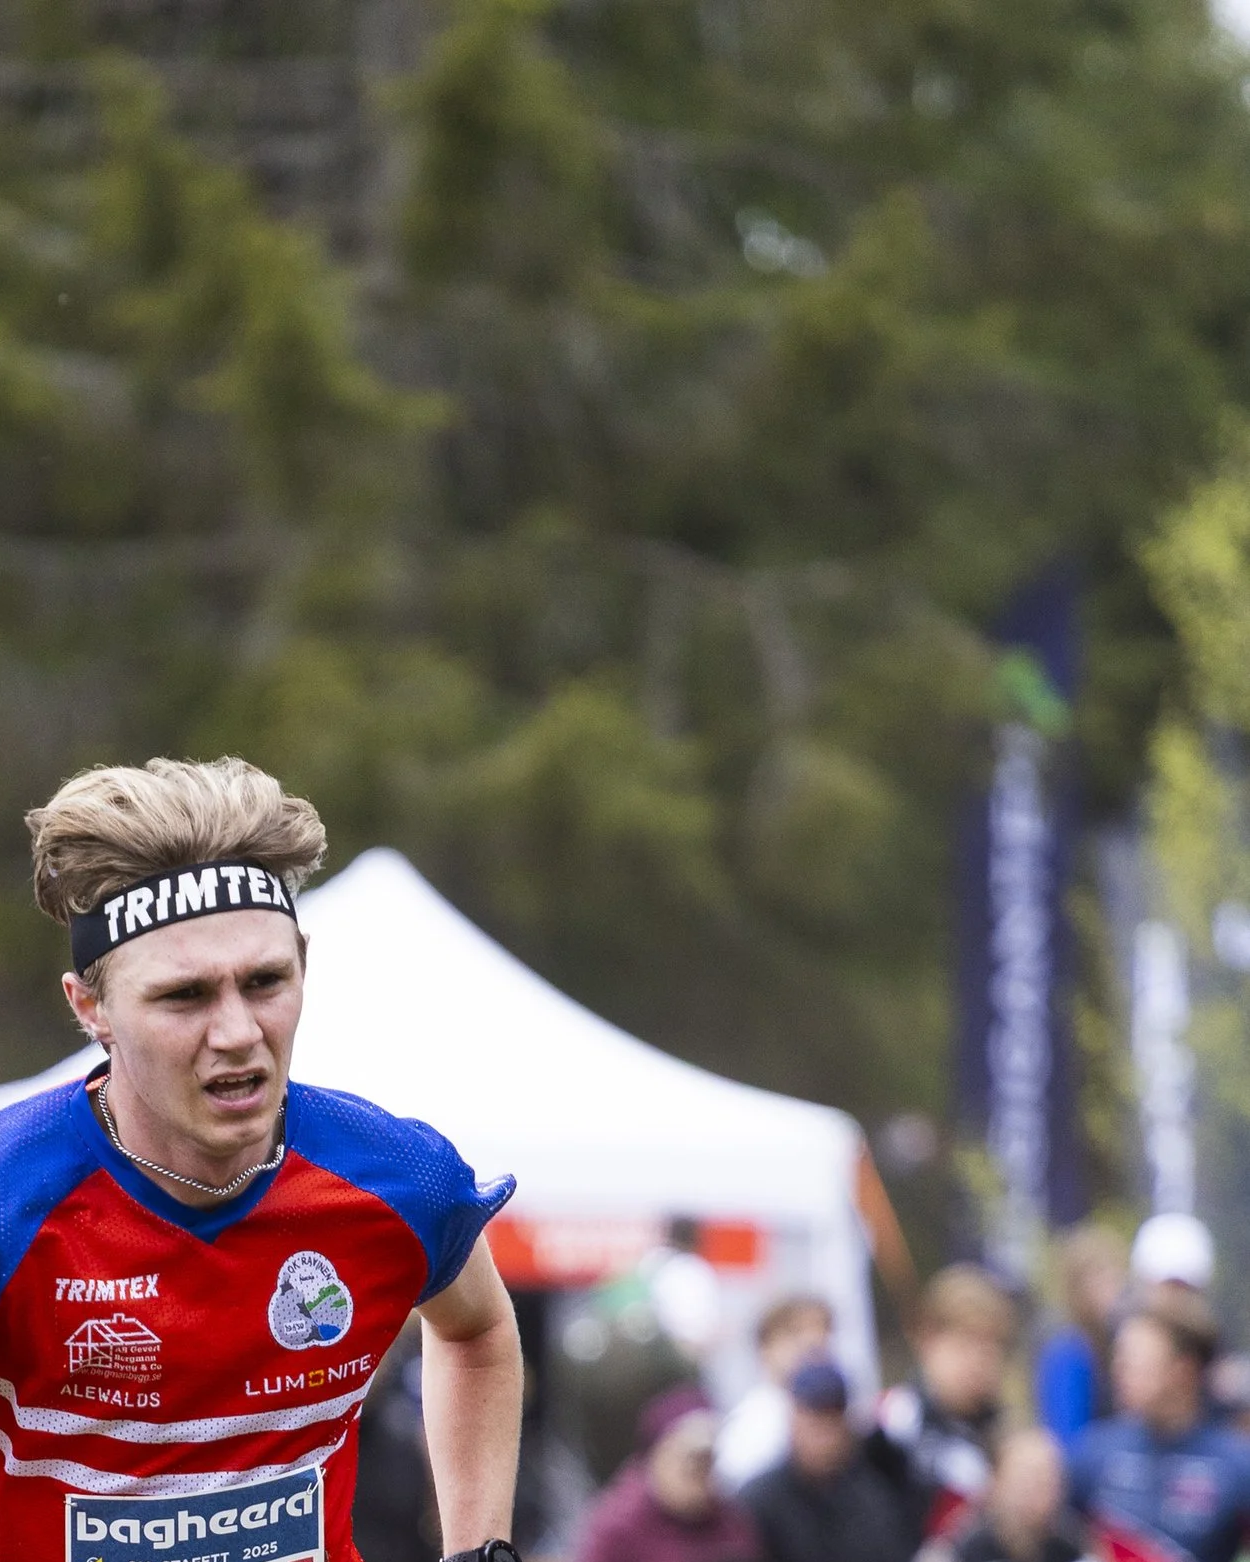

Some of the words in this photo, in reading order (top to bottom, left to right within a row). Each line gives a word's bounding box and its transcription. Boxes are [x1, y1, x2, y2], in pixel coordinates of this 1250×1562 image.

[104, 866, 290, 942] TRIMTEX
[287, 1260, 300, 1274] OK
[55, 1274, 159, 1302] TRIMTEX
[60, 1384, 161, 1408] ALEWALDS
[77, 1490, 312, 1549] bagheera
[243, 1541, 278, 1560] 2025
